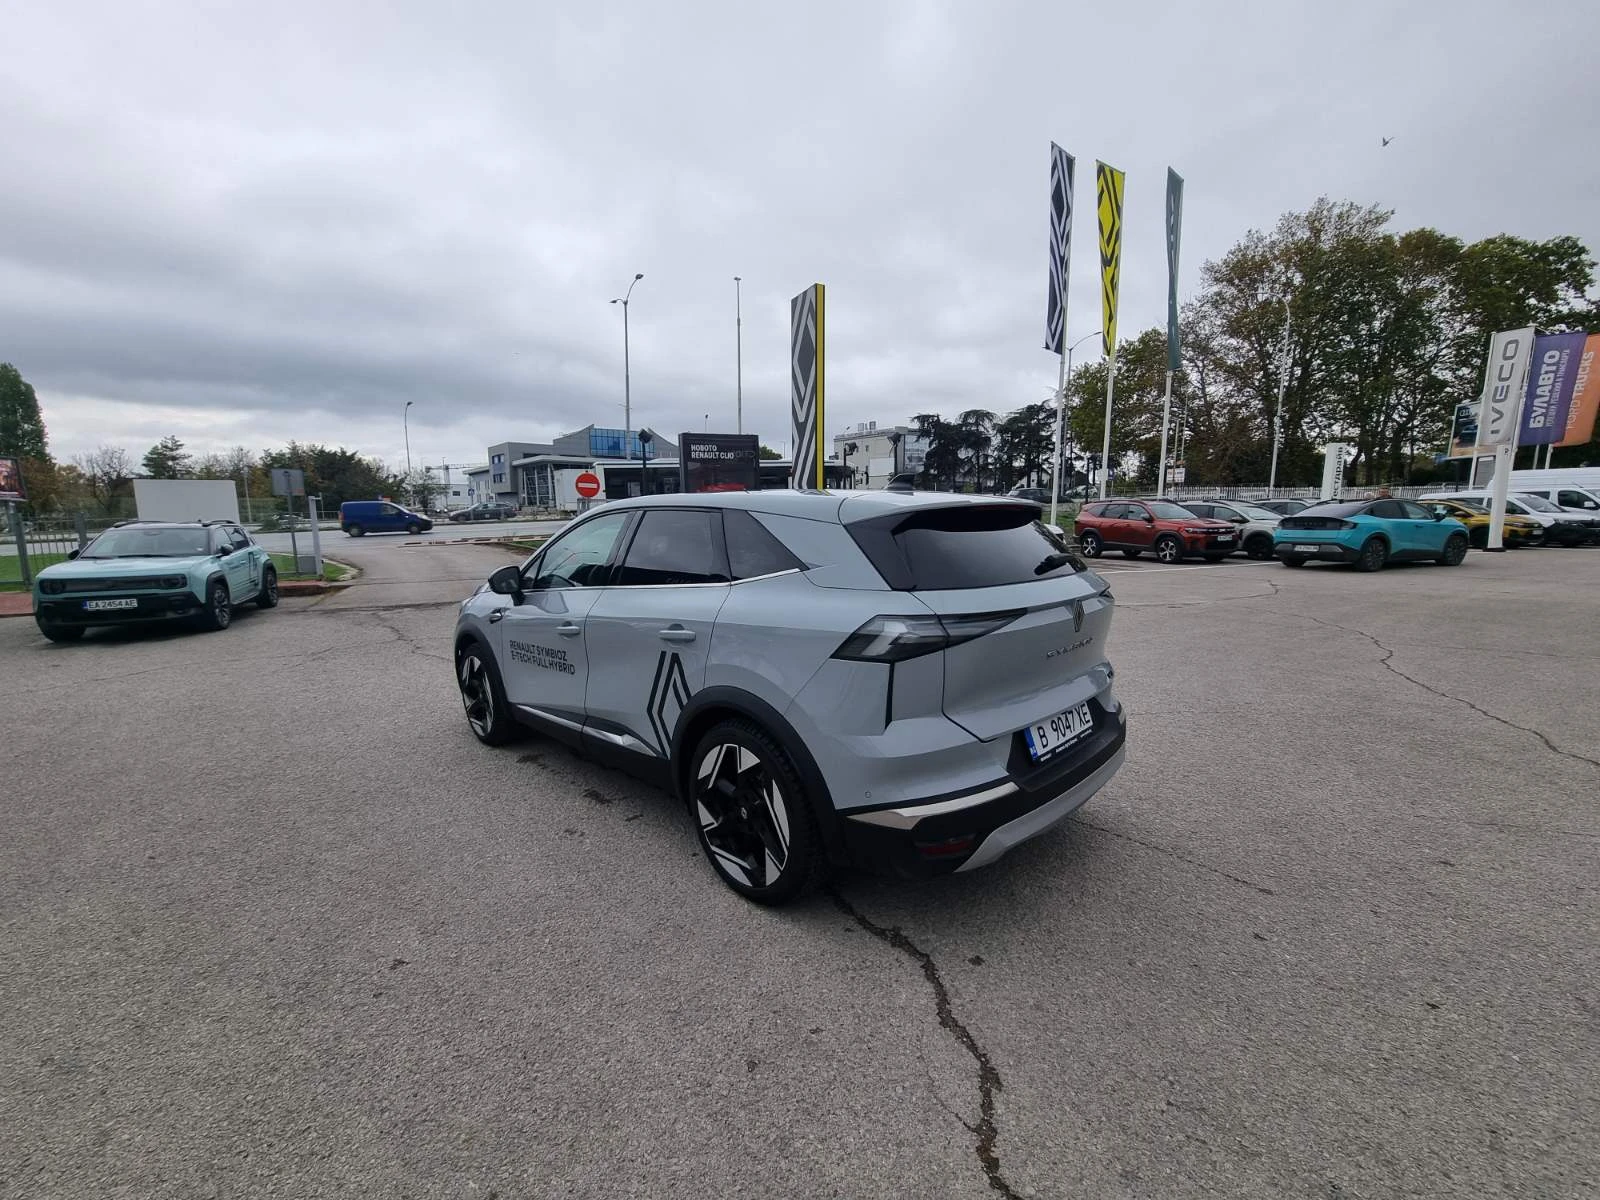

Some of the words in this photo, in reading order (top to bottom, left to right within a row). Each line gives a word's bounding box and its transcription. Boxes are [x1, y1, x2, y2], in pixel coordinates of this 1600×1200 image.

[1490, 339, 1520, 435] IVECO
[1529, 350, 1560, 429] БУЛАВТО
[1571, 352, 1594, 400] TRUCKS
[509, 640, 535, 654] RENAULT
[536, 645, 567, 662] SYMBIOZ
[511, 650, 533, 664] E-TECH
[533, 655, 549, 668] FULL
[549, 659, 576, 675] HYBRID
[1037, 725, 1049, 749] B
[1051, 711, 1075, 741] 9047
[1074, 703, 1090, 727] XE
